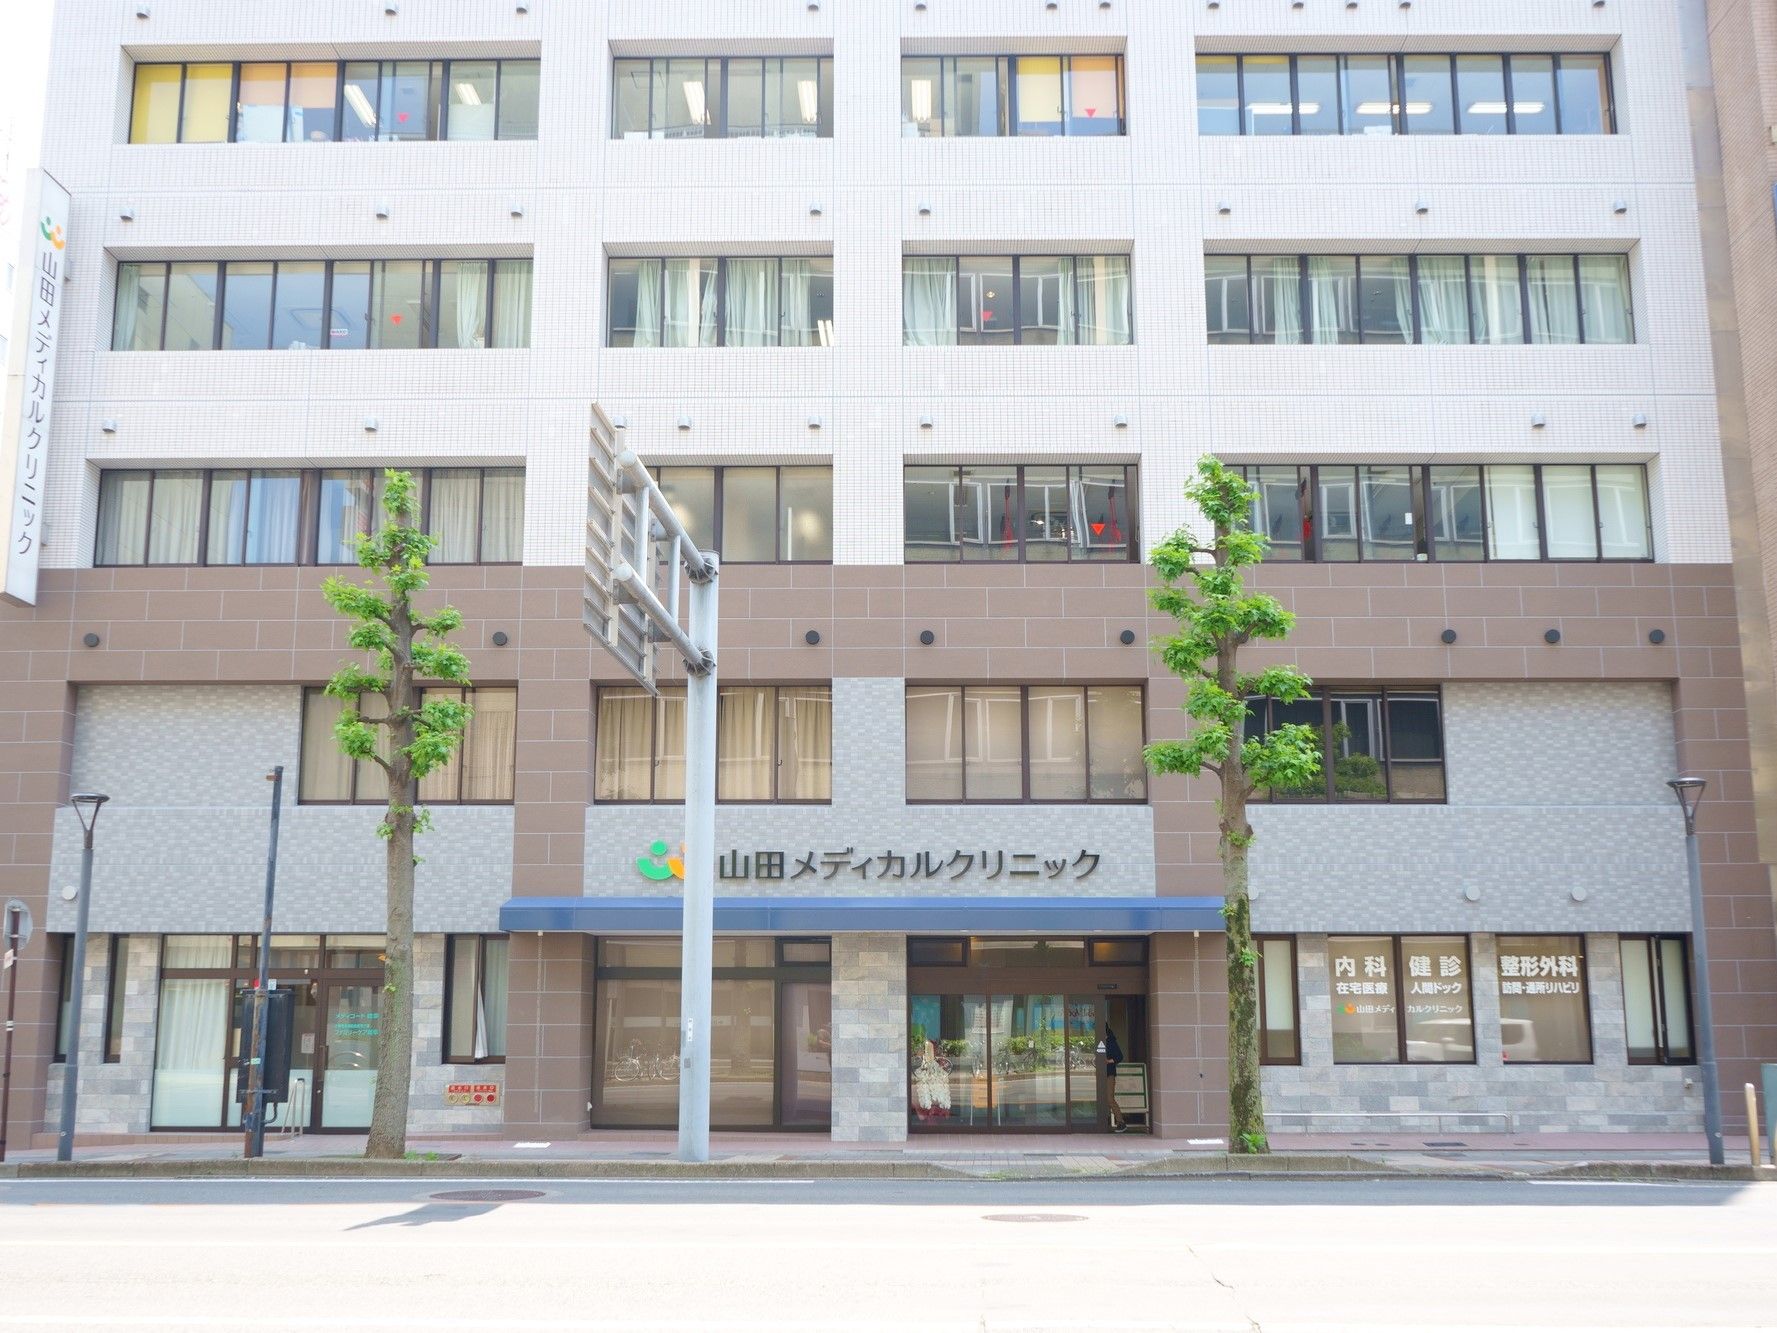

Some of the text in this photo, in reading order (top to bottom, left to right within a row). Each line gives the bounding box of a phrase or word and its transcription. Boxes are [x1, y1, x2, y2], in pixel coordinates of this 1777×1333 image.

[18, 251, 58, 556] 山田メディカルクリニック
[719, 846, 1101, 881] 山田メディカルクリニック
[1335, 955, 1387, 977] 内科
[1409, 955, 1462, 977] 健診
[1500, 955, 1578, 977] 整形外科
[1336, 981, 1388, 995] 在宅医療
[1410, 981, 1462, 994] 人間ドック
